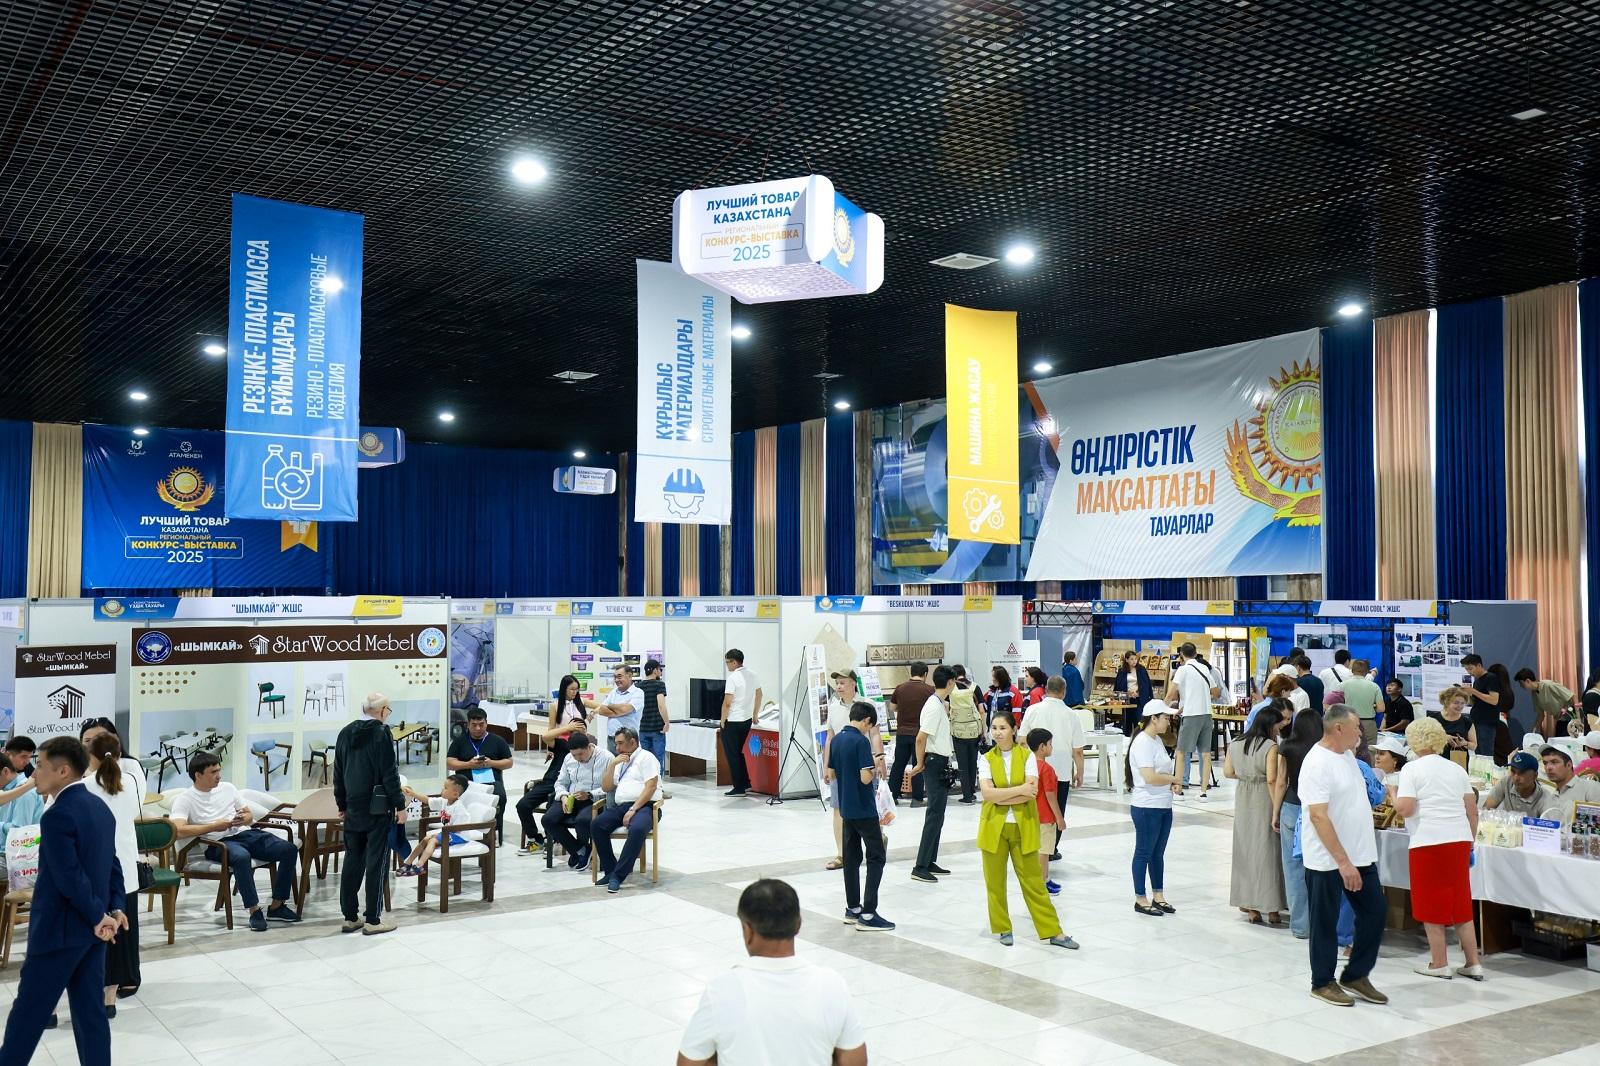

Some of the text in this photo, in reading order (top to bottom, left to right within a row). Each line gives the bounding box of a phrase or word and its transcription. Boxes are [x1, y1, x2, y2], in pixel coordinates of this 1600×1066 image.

[706, 191, 800, 212] ЛУЧШИЙ ТОВАР
[713, 207, 792, 224] КАЗАХСТАНА
[704, 229, 799, 247] КОНКУРС-ВЫСТАВКА
[732, 244, 771, 262] 2025
[307, 253, 328, 363] ПЛАСТМАССОВЫЕ
[268, 311, 297, 416] БҰЙЫМДАРЫ
[702, 295, 714, 443] СТРОИТЕЛЬНЫЕ МАТЕРИАЛЫ
[306, 370, 324, 419] РЕЗИНО
[328, 363, 345, 420] ИЗДЕЛИЯ
[656, 363, 674, 440] ҚҰРЫЛЫС
[1071, 424, 1196, 477] ӨНДІРІСТІК
[1076, 469, 1216, 516] МАҚСАТТАҒЫ
[140, 514, 230, 526] ЛУЧШИЙ ТОВАР
[1150, 512, 1214, 537] ТАУАРЛАР
[131, 541, 237, 550] КОНКУРС-ВЫСТАВКА
[167, 551, 204, 563] 2025
[231, 603, 303, 614] "ШЫМКАЙ" ЖШС
[173, 639, 243, 652] «ШЫМКАЙ»
[272, 632, 414, 654] StarWood Mebel
[37, 650, 111, 662] StarWood Mebel
[45, 662, 88, 671] «ШЫМКАЙ»
